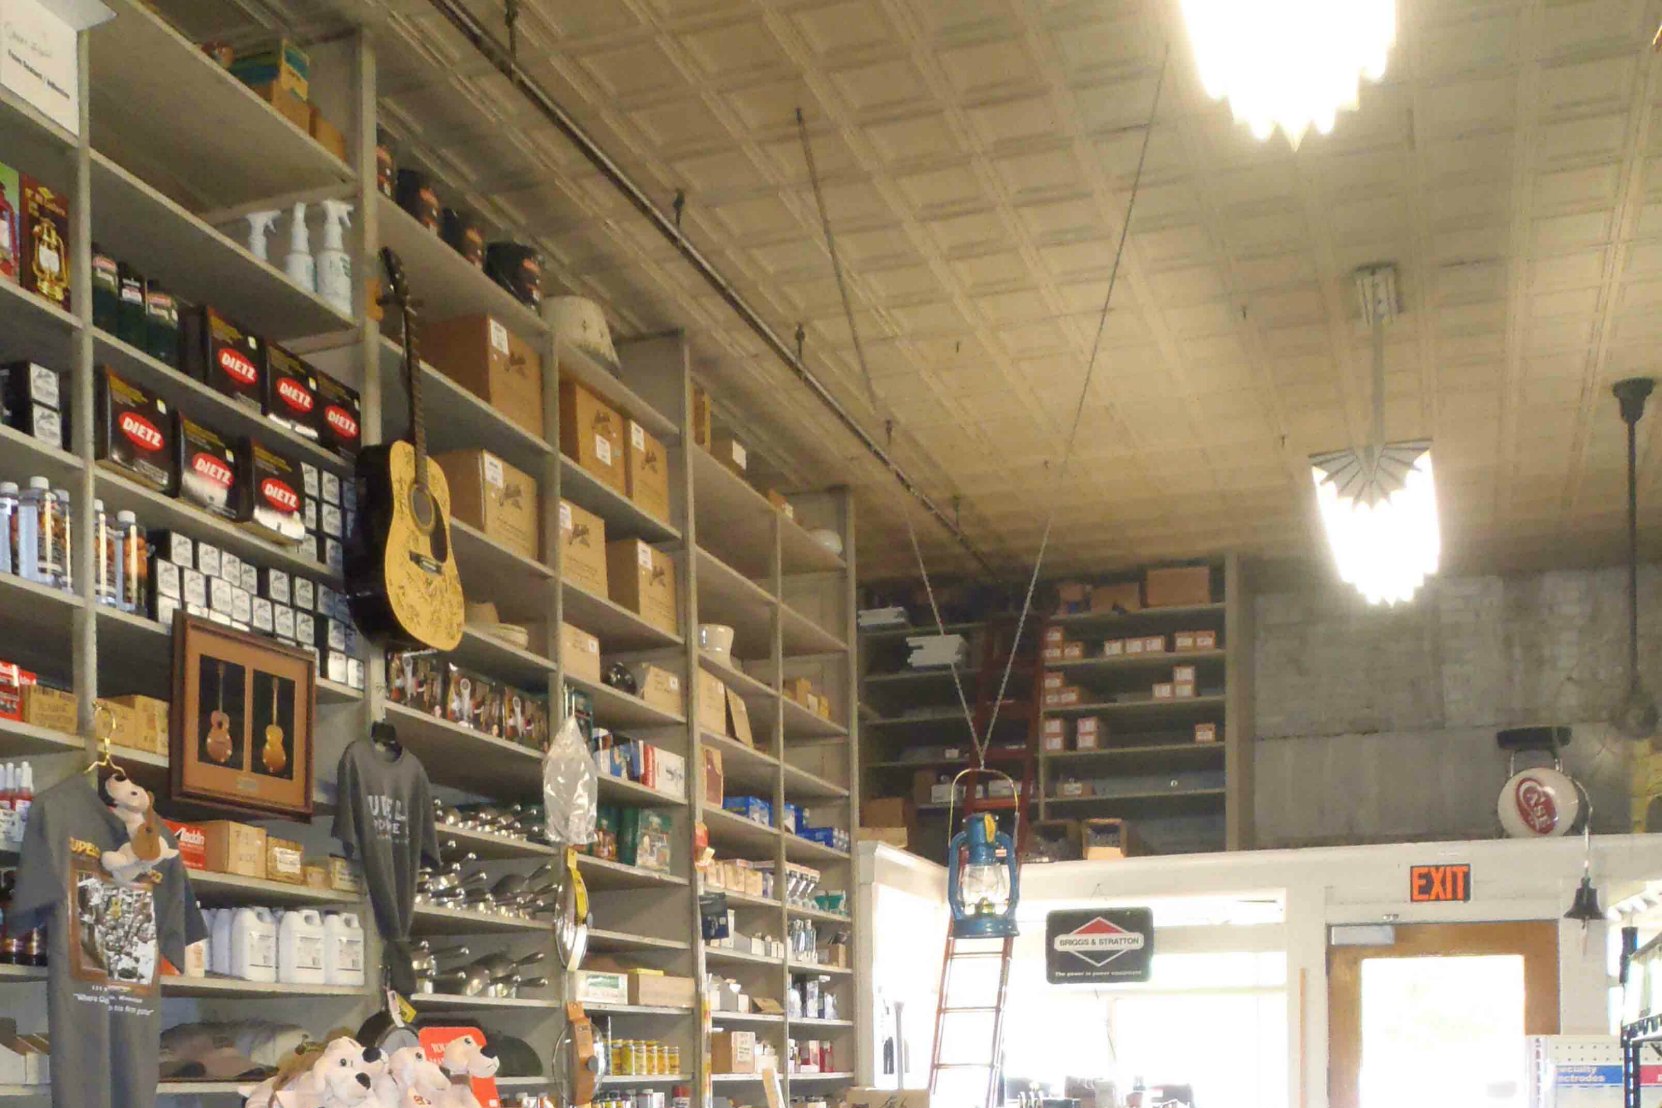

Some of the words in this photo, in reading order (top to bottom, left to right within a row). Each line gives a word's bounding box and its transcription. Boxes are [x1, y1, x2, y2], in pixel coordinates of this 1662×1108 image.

[220, 353, 257, 382] DIETZ
[278, 383, 312, 409] DIETZ
[122, 417, 162, 447] DIETZ
[327, 410, 357, 435] DIETZ
[194, 457, 231, 485] DIETZ
[263, 483, 299, 509] DIETZ
[1411, 865, 1469, 902] EXIT
[1059, 938, 1090, 947] BRIGGS
[1090, 938, 1097, 946] &
[1098, 936, 1140, 946] STRATTON
